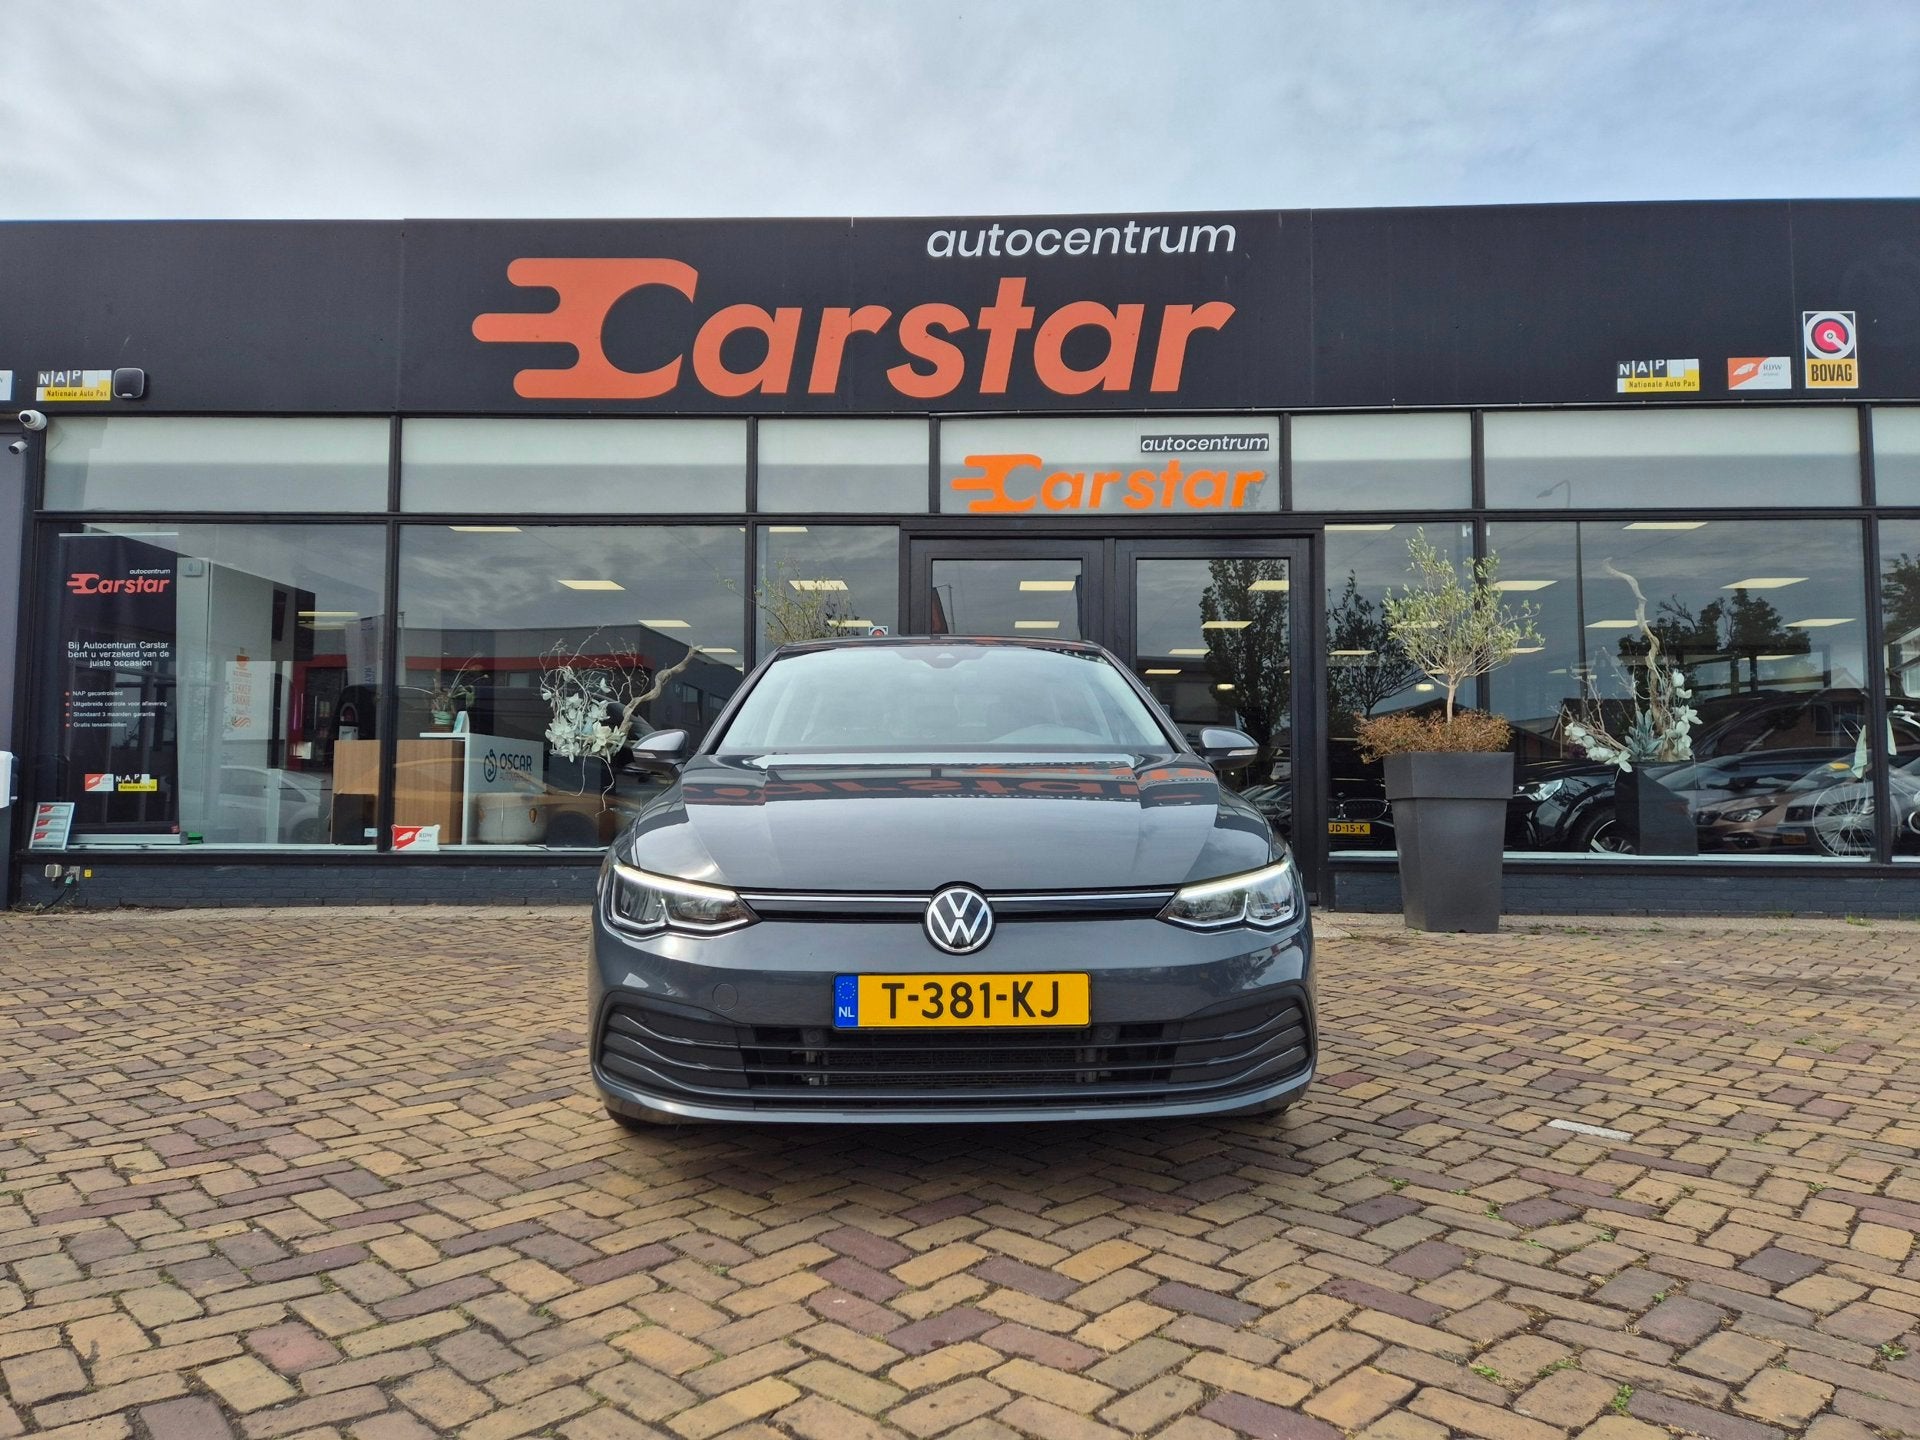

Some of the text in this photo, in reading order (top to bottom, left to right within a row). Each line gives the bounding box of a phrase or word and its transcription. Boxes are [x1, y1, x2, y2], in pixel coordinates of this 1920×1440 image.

[927, 221, 1237, 258] autocentrum
[472, 258, 1236, 399] Carstar
[1811, 363, 1852, 382] BOVAG
[1629, 379, 1696, 388] Nationale Auto Pas
[1141, 436, 1269, 452] autocentrum
[950, 453, 1266, 513] Carstar
[66, 573, 170, 594] Carstar
[67, 641, 169, 650] Bij Autocentrum Carstar
[67, 650, 88, 658] bent
[99, 650, 140, 658] verzekerd
[159, 650, 170, 658] de
[89, 659, 152, 668] juiste occasion
[499, 753, 533, 771] OSCAR
[838, 981, 1059, 1019] NL T-381-KJ
